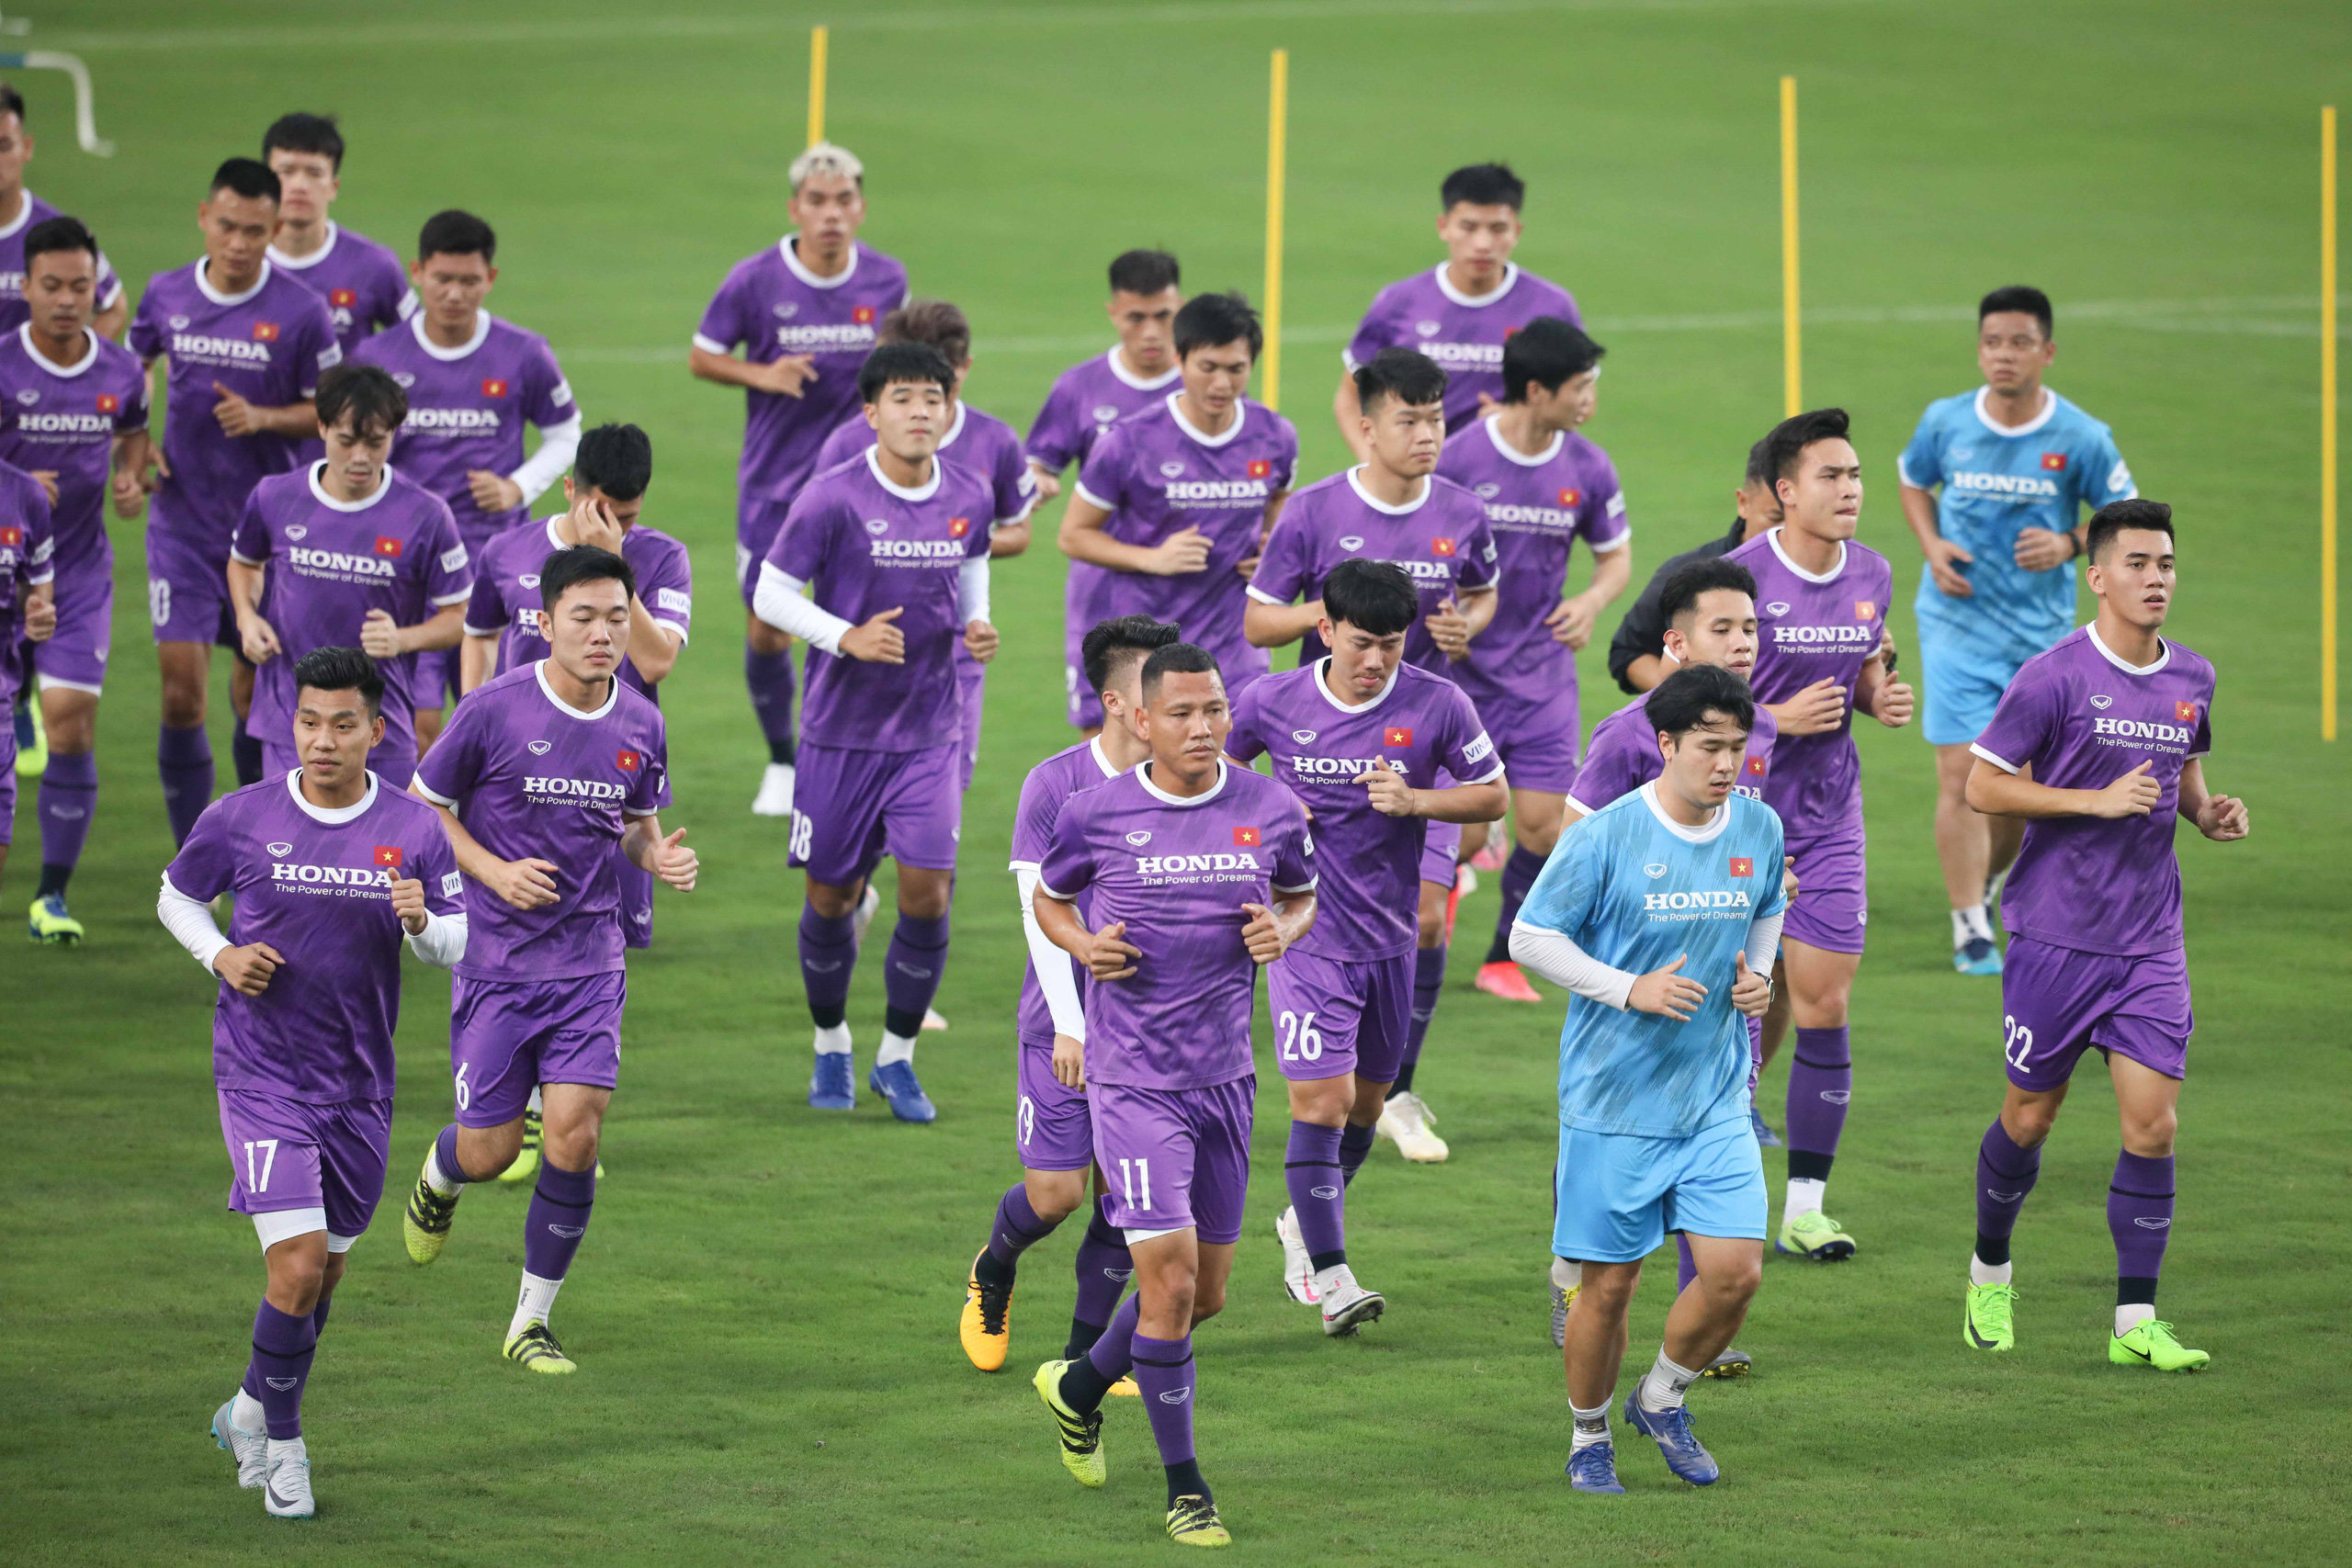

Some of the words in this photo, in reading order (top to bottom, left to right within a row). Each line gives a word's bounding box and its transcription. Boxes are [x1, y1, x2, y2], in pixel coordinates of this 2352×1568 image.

[778, 324, 876, 344] HONDA
[172, 333, 272, 362] HONDA
[1419, 342, 1505, 363] HOND
[17, 413, 112, 432] HONDA
[1164, 479, 1269, 500] HONDA
[1953, 470, 2057, 496] HONDA
[1484, 503, 1576, 528] HONDA
[870, 539, 965, 558] HONDA
[289, 546, 397, 577] HONDA
[294, 565, 309, 576] The
[310, 567, 340, 581] Power
[341, 571, 352, 582] of
[354, 573, 391, 588] Dreams
[522, 625, 538, 636] The
[1773, 626, 1871, 643] HONDA
[1777, 645, 1796, 654] The
[1797, 645, 1826, 654] Power
[1826, 645, 1837, 654] of
[1838, 644, 1868, 653] Dreams
[2094, 717, 2190, 743] HONDA
[2097, 737, 2115, 746] The
[2117, 739, 2143, 750] Power
[2144, 742, 2154, 750] of
[2156, 743, 2186, 755] Dreams
[523, 777, 628, 800] HONDA
[1296, 773, 1315, 784] The
[1316, 775, 1350, 785] Power
[526, 795, 545, 804] The
[547, 795, 578, 807] Power
[580, 799, 590, 808] of
[591, 800, 621, 809] Dreams
[1136, 853, 1261, 874] HONDA
[271, 863, 392, 888] HONDA
[1141, 876, 1163, 886] The
[1165, 875, 1200, 885] Power
[1202, 874, 1215, 883] of
[1216, 874, 1257, 883] Dreams
[275, 883, 296, 893] The
[298, 885, 334, 896] Power
[335, 888, 347, 897] of
[349, 889, 390, 900] Dreams
[1644, 891, 1751, 910] HONDA
[1647, 913, 1668, 922] The
[1669, 913, 1700, 922] Power
[1701, 911, 1712, 920] of
[1713, 910, 1747, 919] Dreams
[1280, 1010, 1322, 1060] 26
[2005, 1015, 2033, 1073] 22
[456, 1063, 469, 1111] 6
[244, 1139, 278, 1192] 17
[1119, 1158, 1150, 1210] 11
